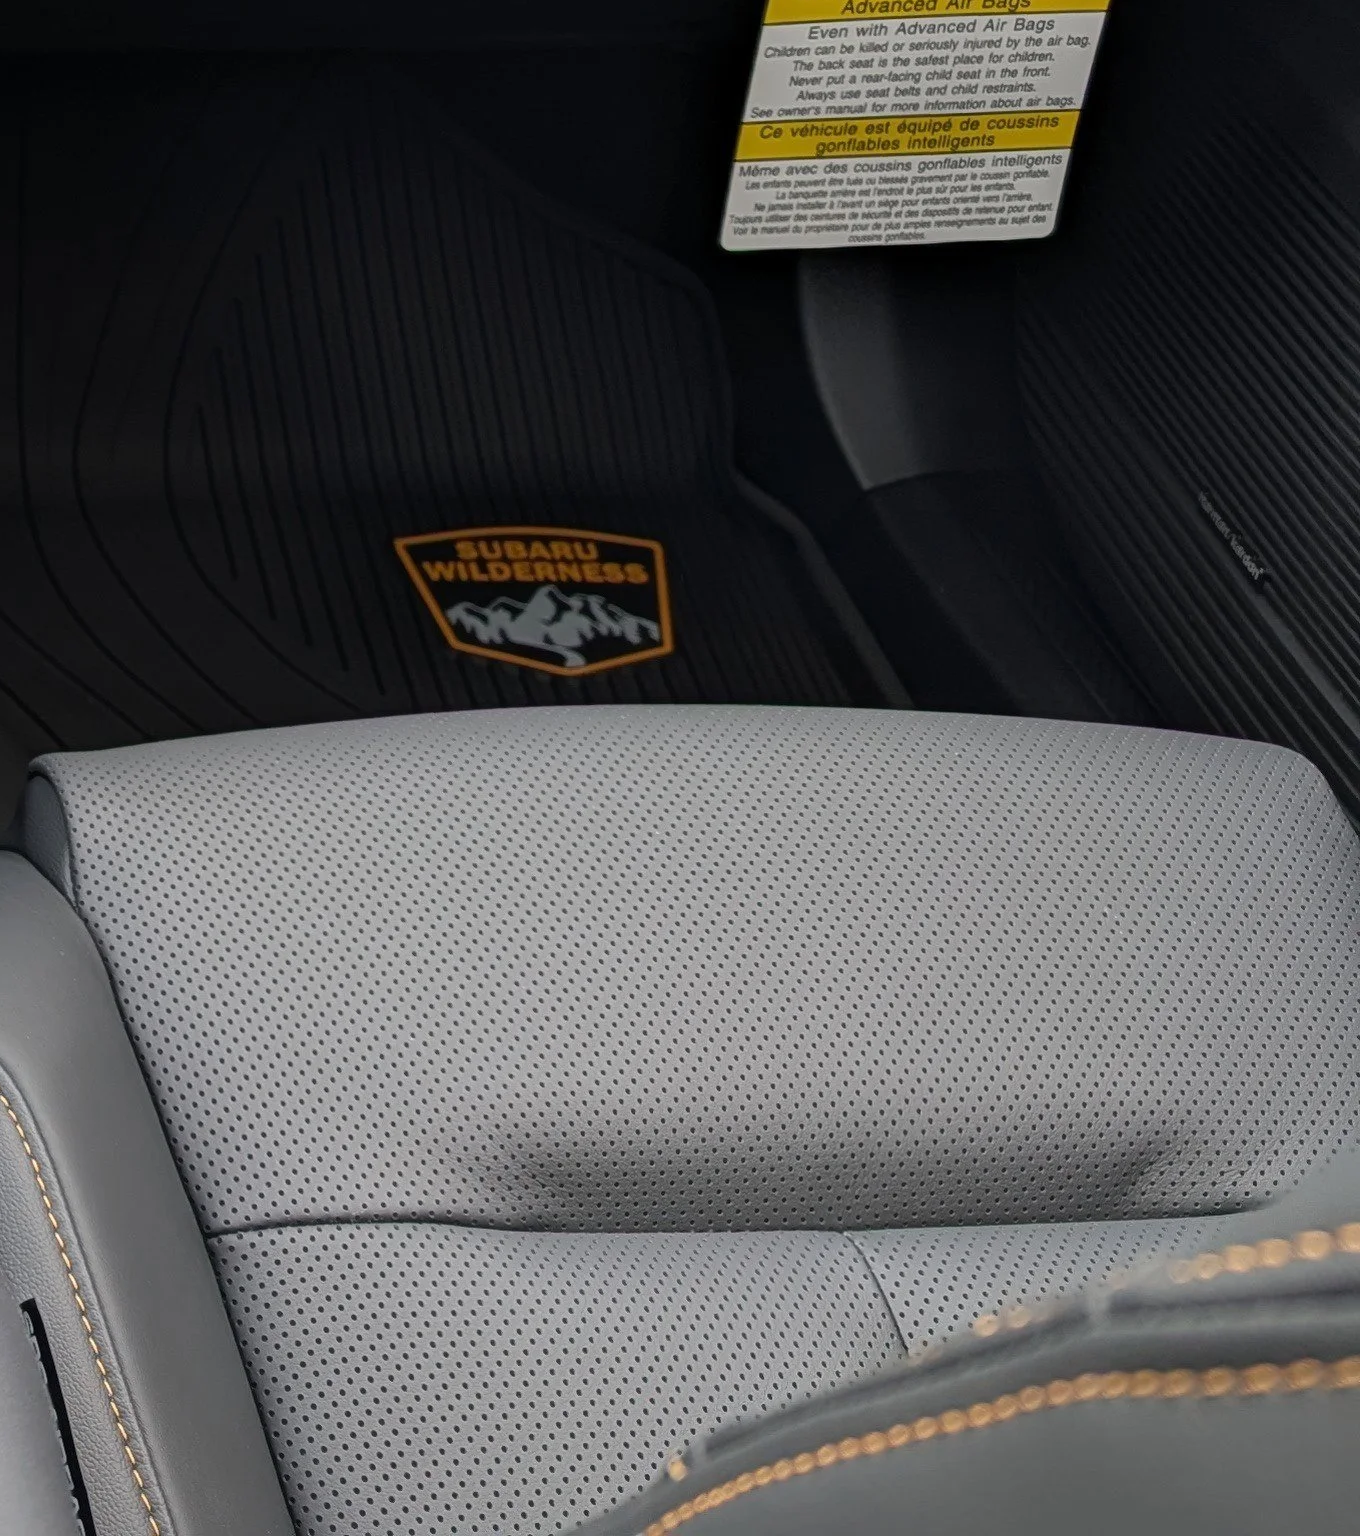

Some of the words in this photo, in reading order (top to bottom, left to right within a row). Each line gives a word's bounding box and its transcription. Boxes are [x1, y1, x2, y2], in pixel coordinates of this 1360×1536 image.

[807, 25, 849, 40] Even
[856, 23, 888, 37] with
[895, 19, 977, 36] Advanced
[983, 18, 1008, 33] Air
[1013, 17, 1056, 34] Bags
[763, 46, 811, 59] Children
[814, 45, 836, 56] can
[839, 43, 855, 54] be
[859, 41, 889, 54] killed
[892, 42, 905, 52] or
[908, 40, 959, 56] seriously
[963, 37, 1002, 52] injured
[1005, 36, 1020, 51] by
[1024, 35, 1043, 47] the
[1047, 34, 1065, 46] air
[1066, 34, 1091, 48] bag.
[793, 60, 814, 72] The
[818, 58, 845, 70] back
[849, 57, 874, 69] seat
[878, 57, 888, 68] is
[892, 56, 911, 67] the
[915, 53, 950, 66] safest
[952, 52, 984, 67] place
[988, 51, 1005, 64] for
[1007, 50, 1055, 63] children.
[759, 124, 783, 139] Ce
[790, 122, 858, 137] véhicule
[864, 122, 891, 135] est
[896, 118, 953, 136] équipé
[959, 117, 981, 132] de
[986, 115, 1060, 130] coussins
[815, 138, 901, 158] gonflables
[906, 133, 996, 152] intelligents
[785, 164, 818, 175] avec
[823, 161, 848, 174] des
[853, 160, 912, 173] coussins
[917, 156, 986, 174] gonflables
[991, 153, 1063, 169] intelligents
[454, 540, 599, 561] SUBARU
[422, 560, 650, 584] WILDERNESS
